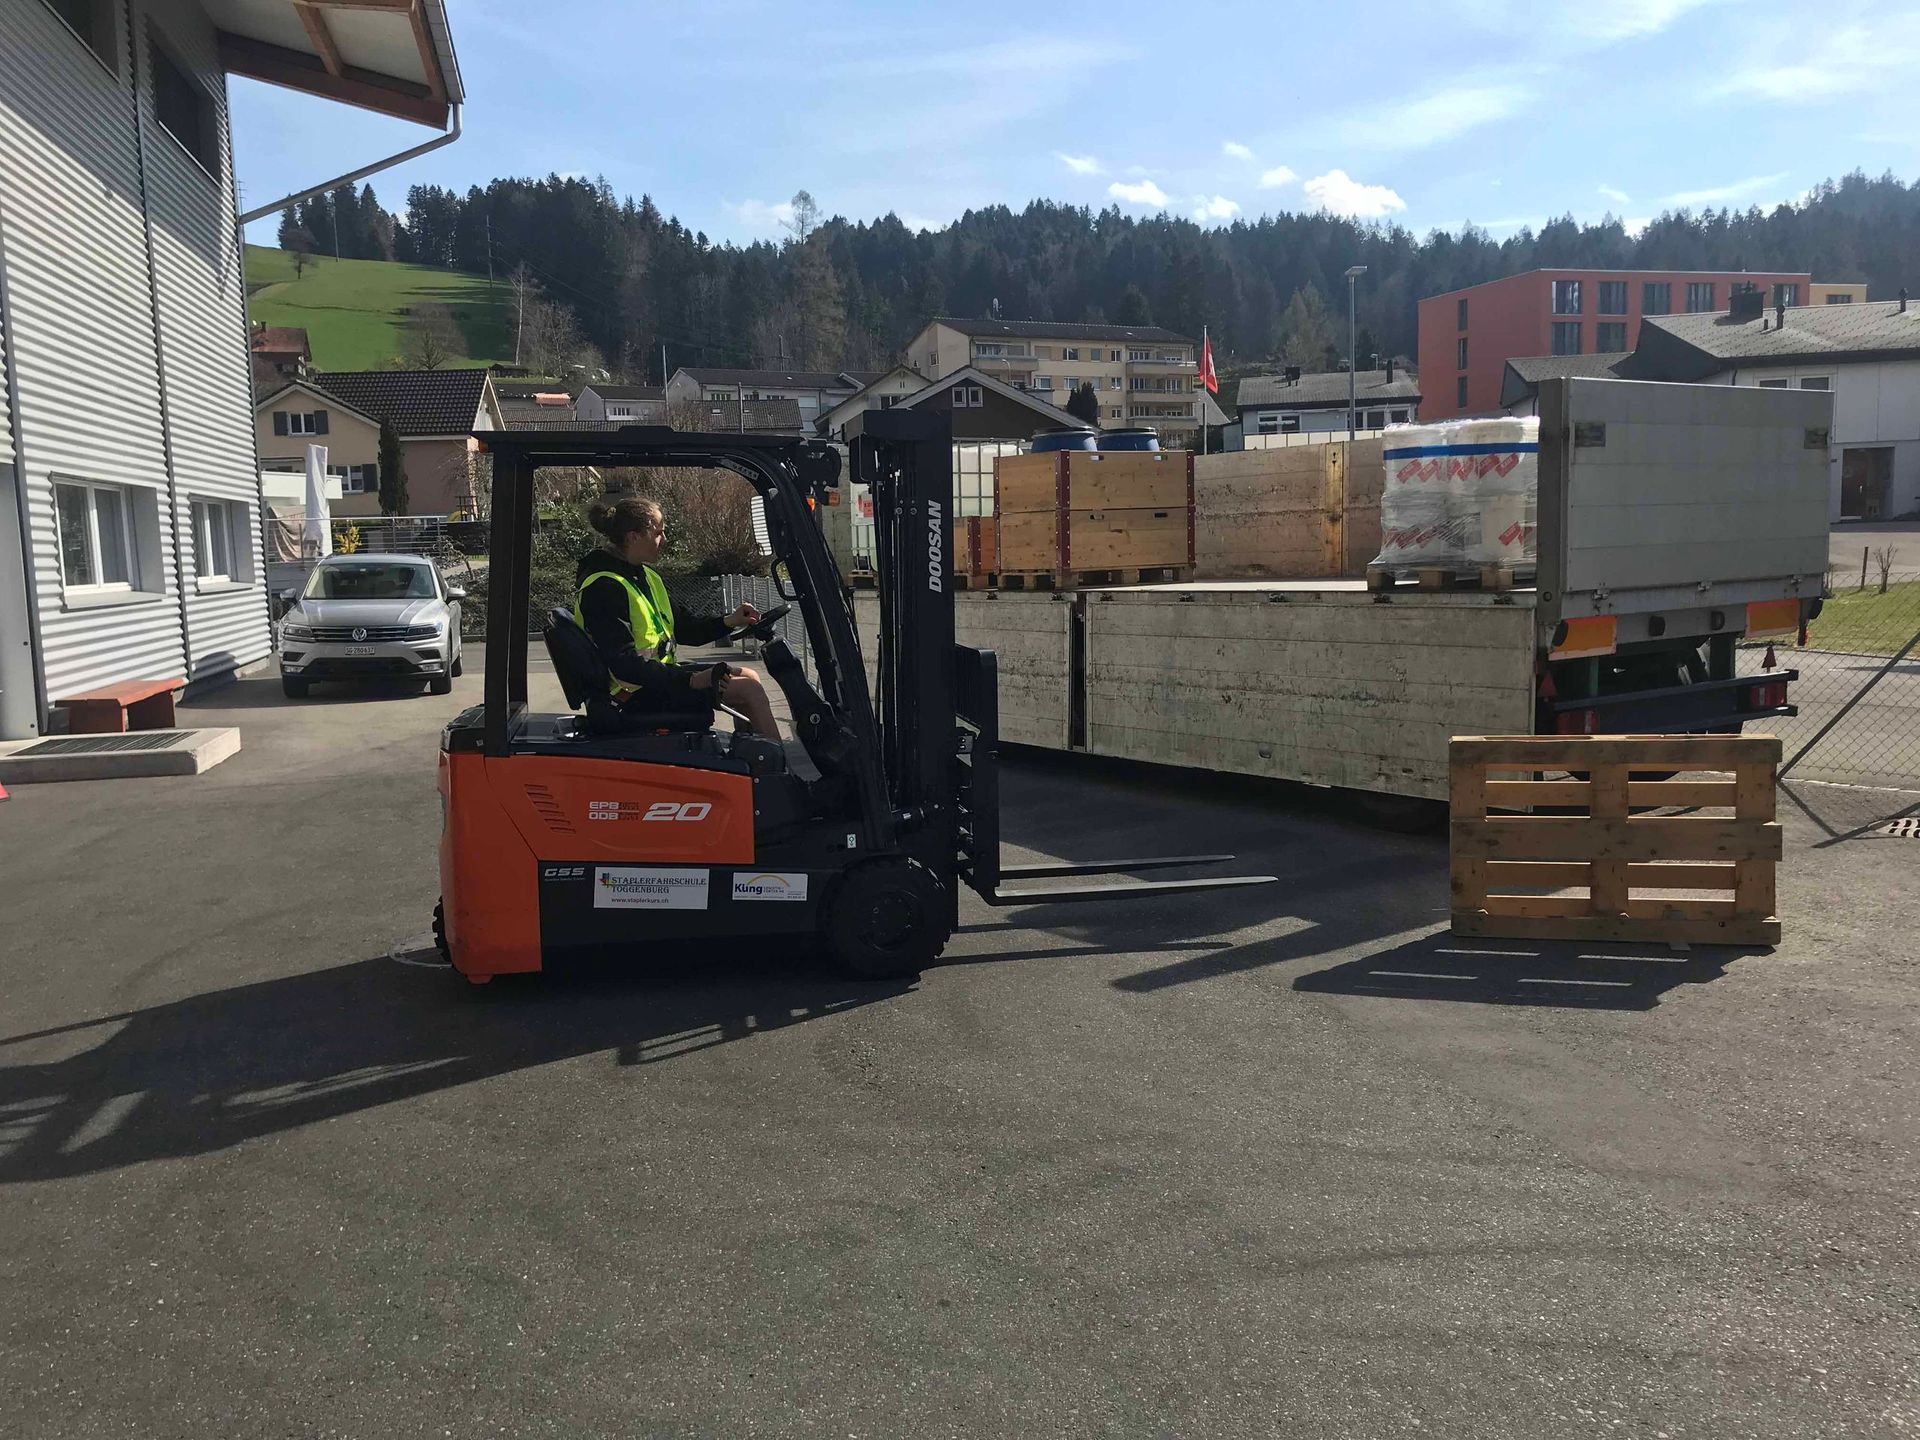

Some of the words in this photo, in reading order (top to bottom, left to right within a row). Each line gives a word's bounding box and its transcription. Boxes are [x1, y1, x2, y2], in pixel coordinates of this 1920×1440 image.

[928, 500, 941, 593] DOOSAN
[642, 802, 712, 821] 20
[544, 867, 585, 877] GSS
[611, 876, 707, 886] STAPLERFAHRSCHULE
[612, 885, 670, 894] TOGGENBURG
